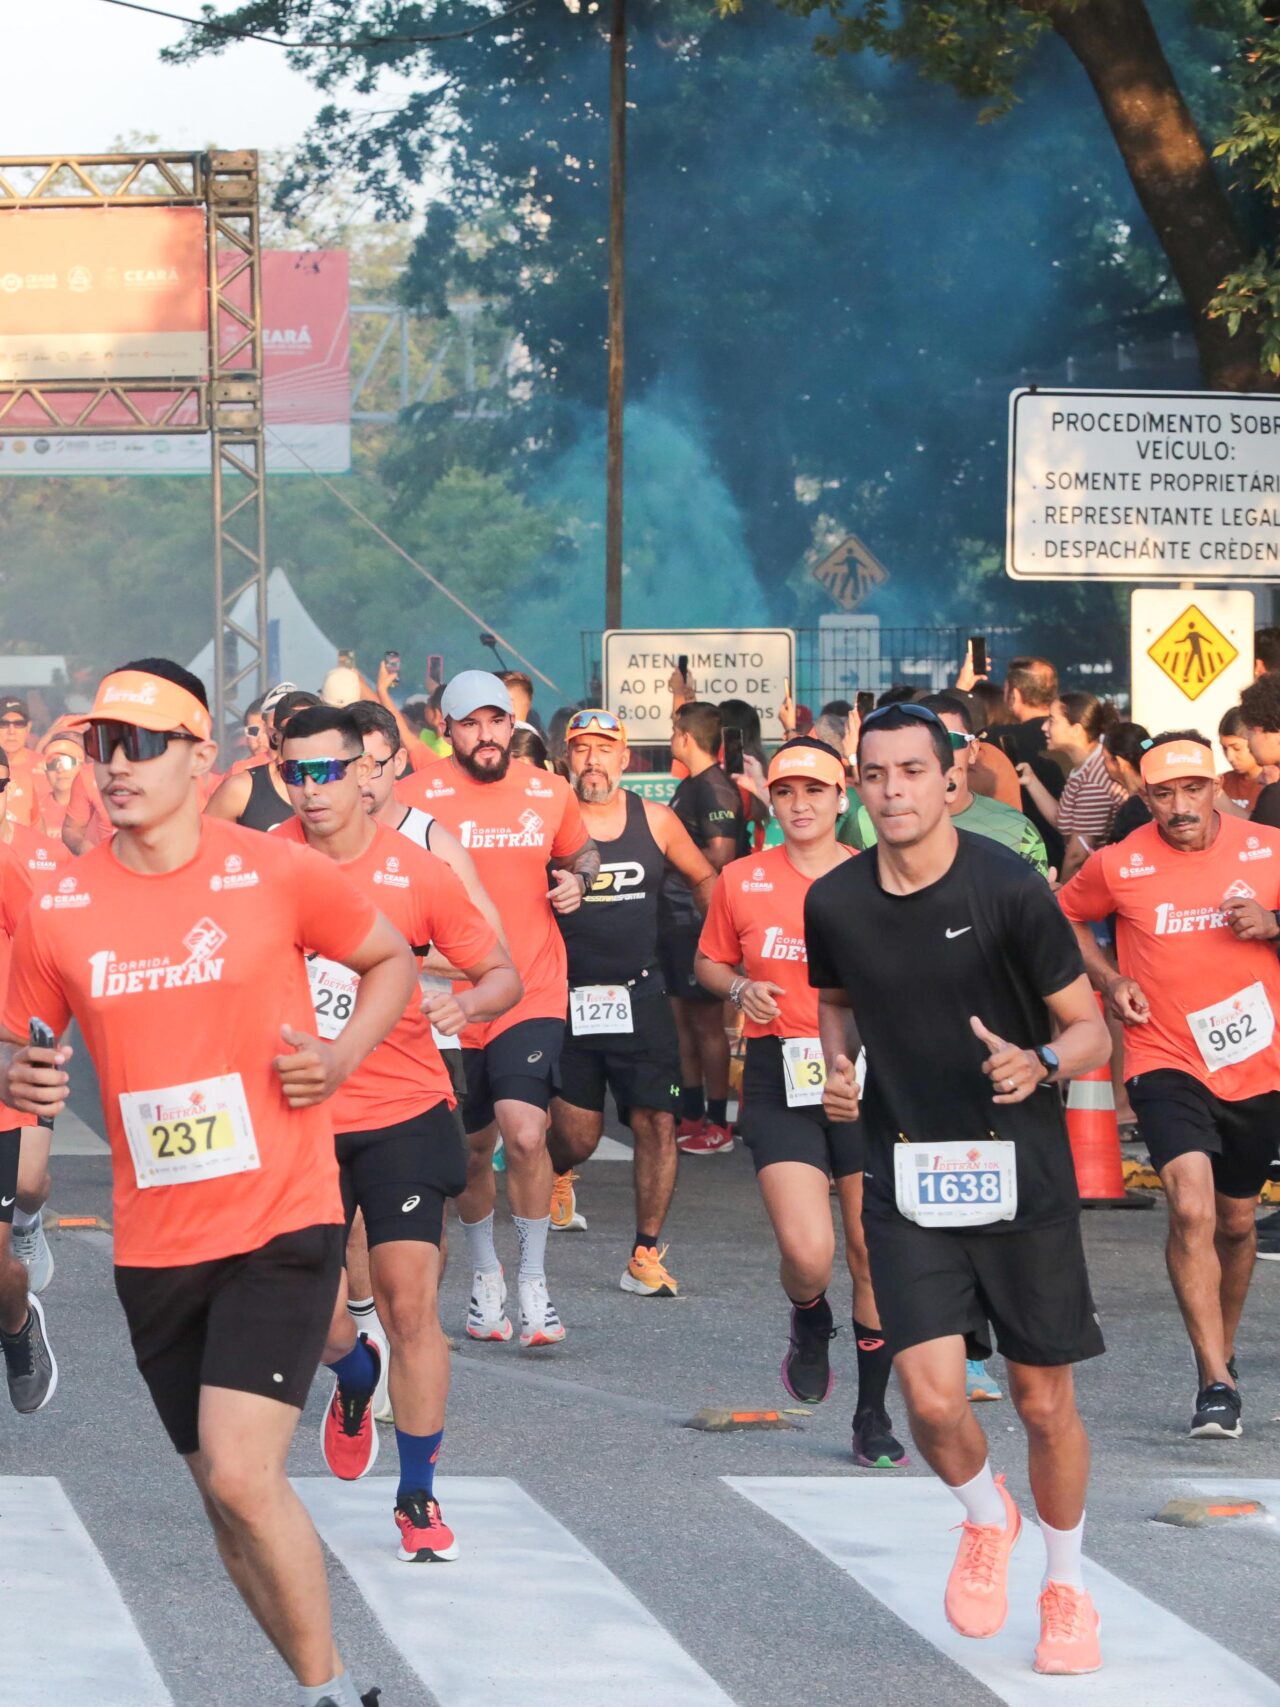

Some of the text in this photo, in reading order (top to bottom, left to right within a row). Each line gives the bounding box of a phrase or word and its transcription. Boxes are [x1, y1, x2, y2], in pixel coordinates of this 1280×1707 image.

[124, 266, 179, 281] CEARÁ
[261, 325, 312, 343] EARÁ
[1051, 412, 1221, 433] PROCEDIMENTO
[1045, 472, 1141, 491] SOMENTE
[1045, 507, 1213, 525] REPRESENTANTE
[1045, 541, 1191, 559] DESPACHANTE
[628, 653, 763, 668] ATENIMENTO
[620, 679, 770, 694] AO PLICO DE
[618, 705, 661, 720] 8:00
[623, 784, 675, 798] CESS
[471, 833, 544, 848] DETRAN
[1169, 907, 1214, 919] CORRIDA
[1166, 911, 1232, 934] DETR
[109, 956, 171, 973] CORRIDA
[106, 958, 224, 997] DETRAN
[575, 1002, 628, 1021] 1278
[1208, 1013, 1257, 1051] 962
[152, 1115, 217, 1158] 237
[921, 1172, 1000, 1203] 1638
